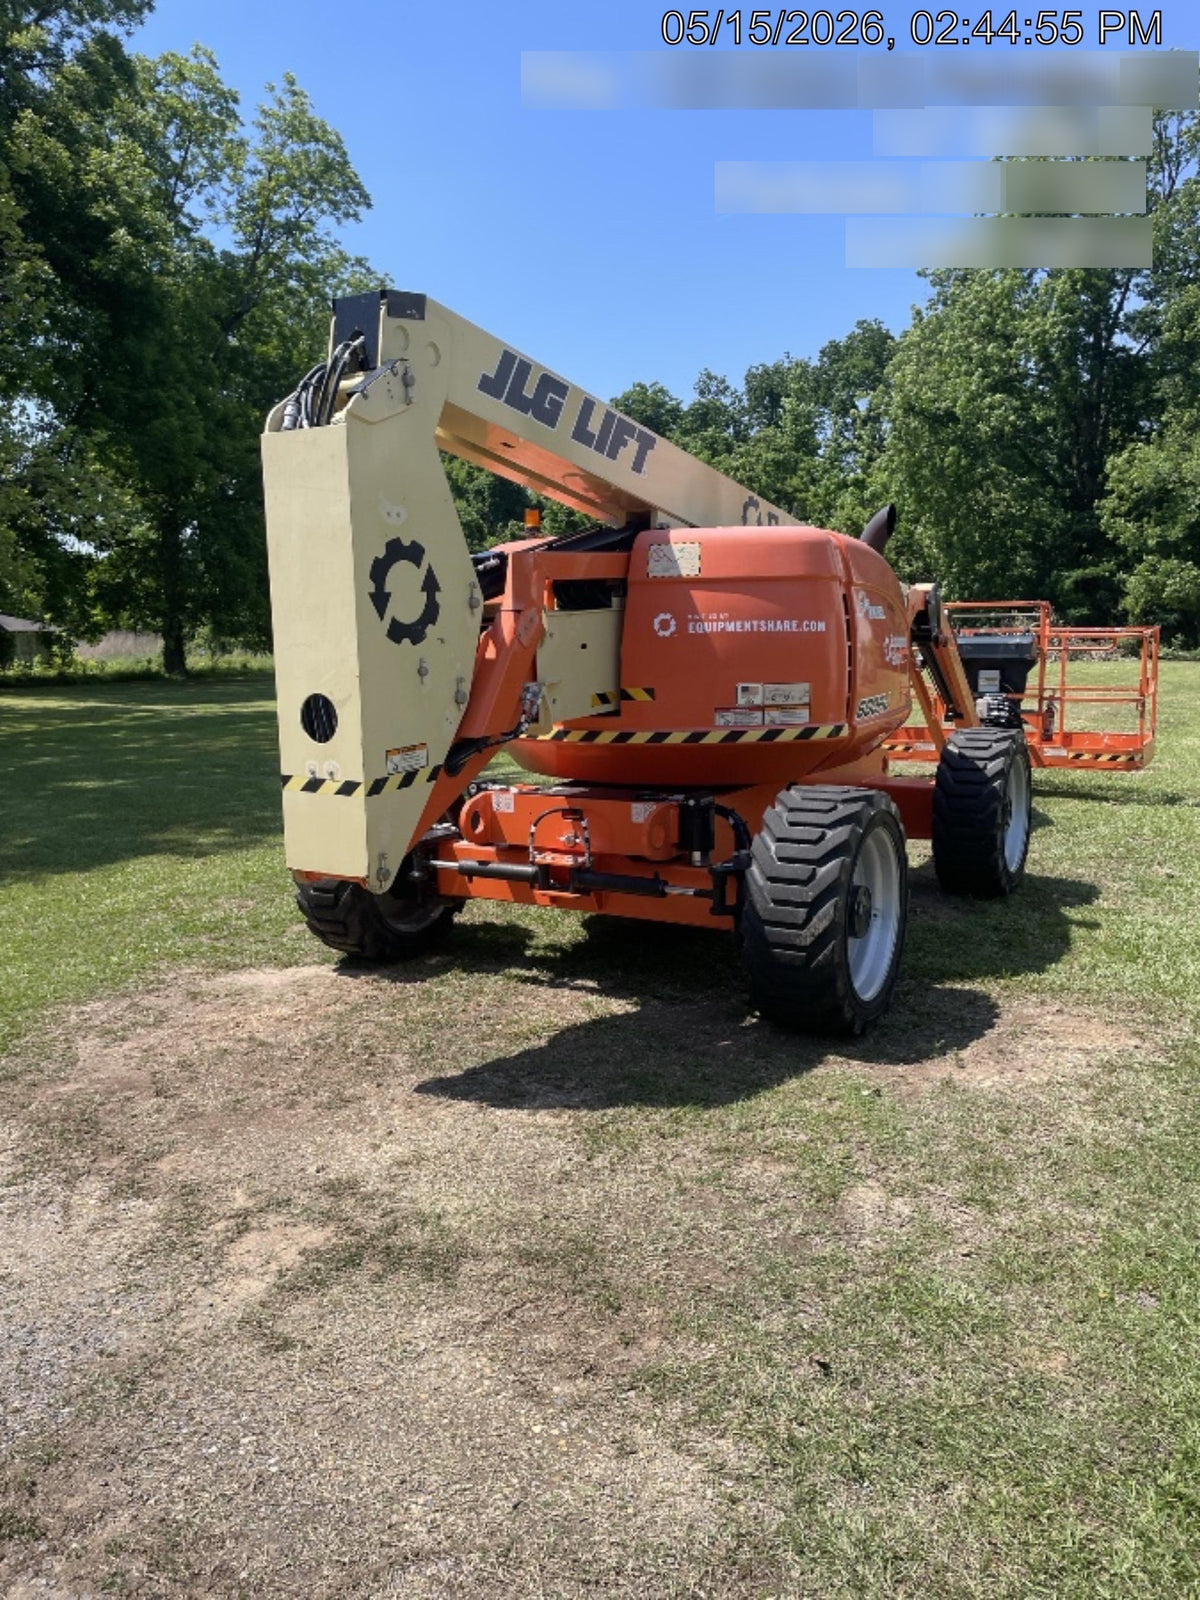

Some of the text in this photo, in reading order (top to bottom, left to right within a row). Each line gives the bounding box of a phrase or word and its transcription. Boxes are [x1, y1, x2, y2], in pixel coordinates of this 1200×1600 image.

[478, 350, 657, 475] JLG LIFT
[688, 620, 826, 634] EQUIPMENTSHARE.COM
